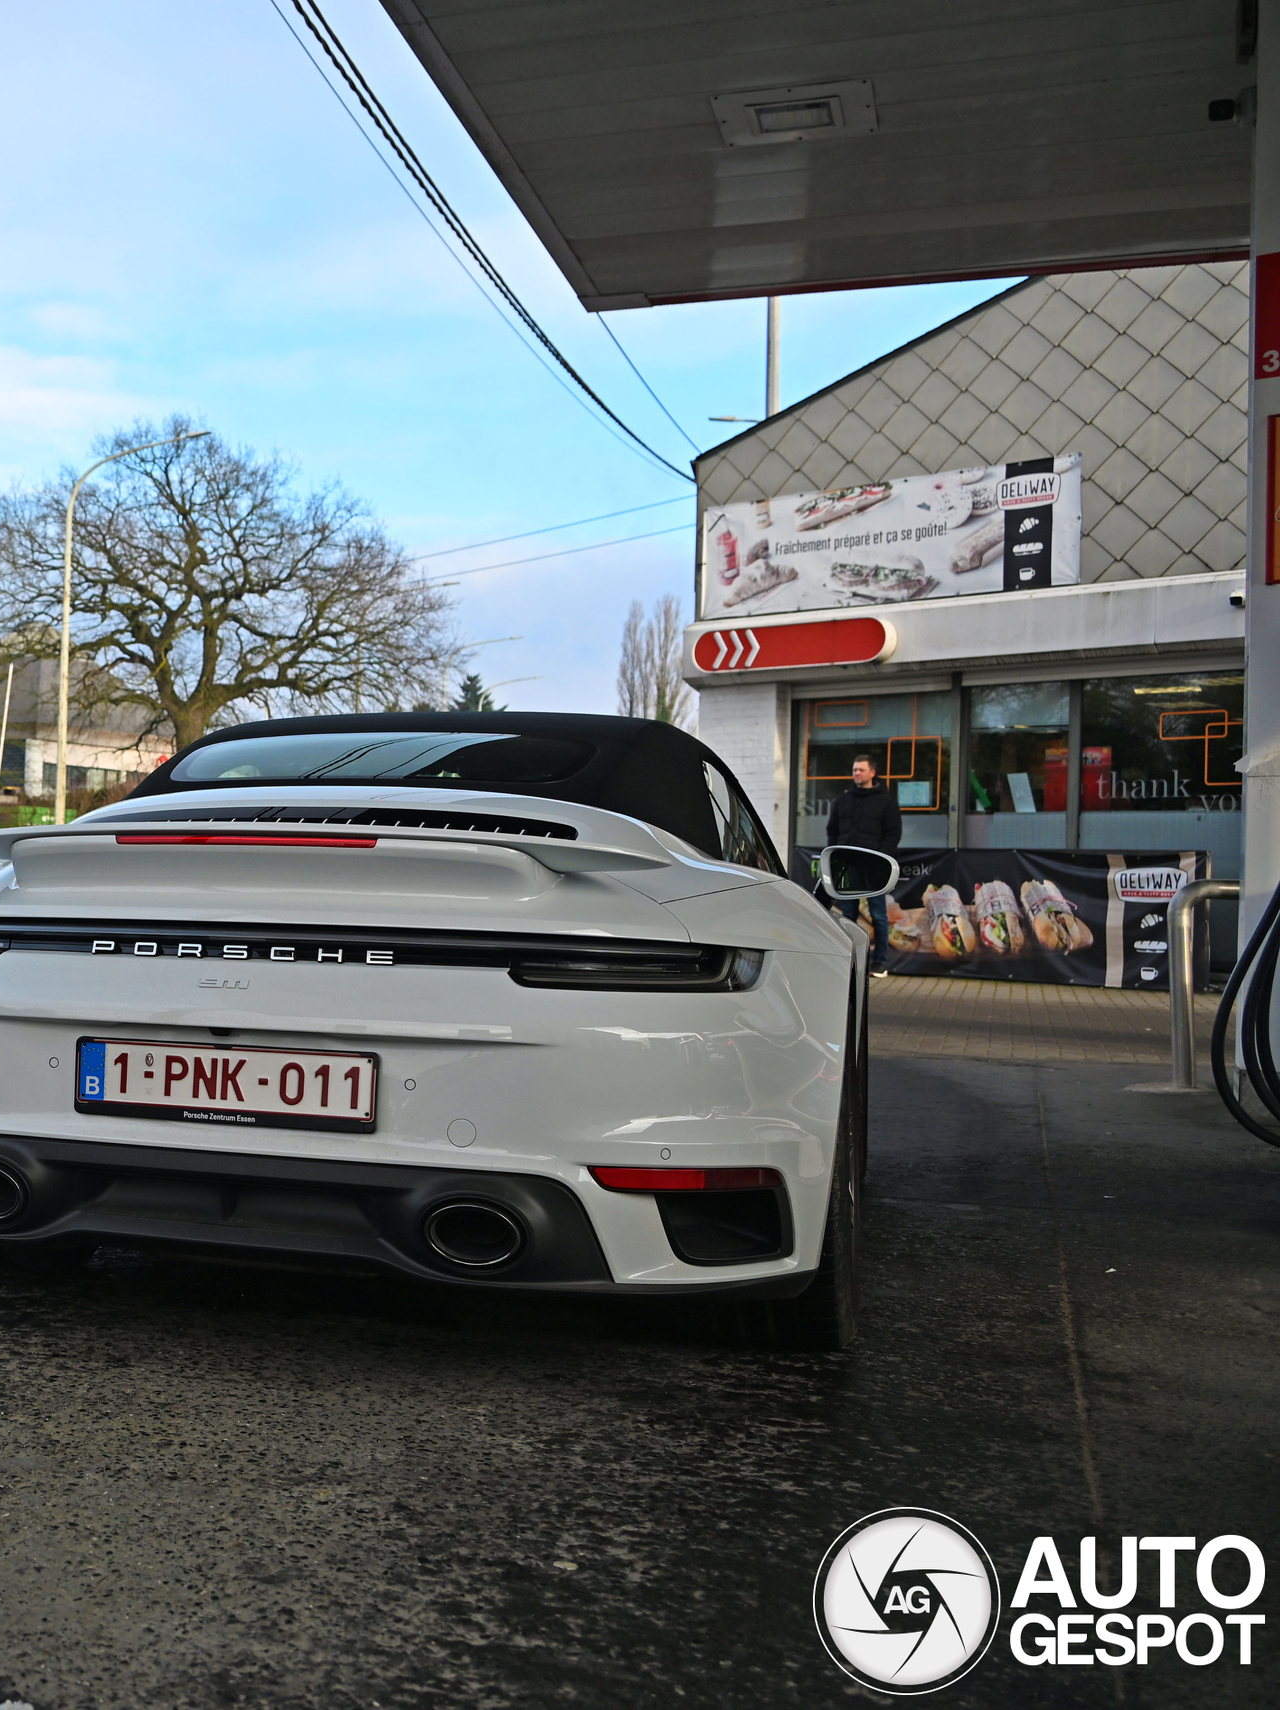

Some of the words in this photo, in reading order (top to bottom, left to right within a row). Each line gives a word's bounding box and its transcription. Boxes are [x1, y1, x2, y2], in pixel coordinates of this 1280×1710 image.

[833, 532, 871, 552] préparé
[873, 531, 883, 544] et
[886, 529, 898, 544] ça
[901, 528, 913, 541] se
[915, 521, 948, 542] goûte!
[1096, 770, 1193, 800] thank
[91, 940, 394, 965] PORSCHE
[85, 1075, 100, 1095] B
[183, 1111, 208, 1120] Porsche
[209, 1112, 236, 1122] Zentrum
[236, 1114, 256, 1123] Essen
